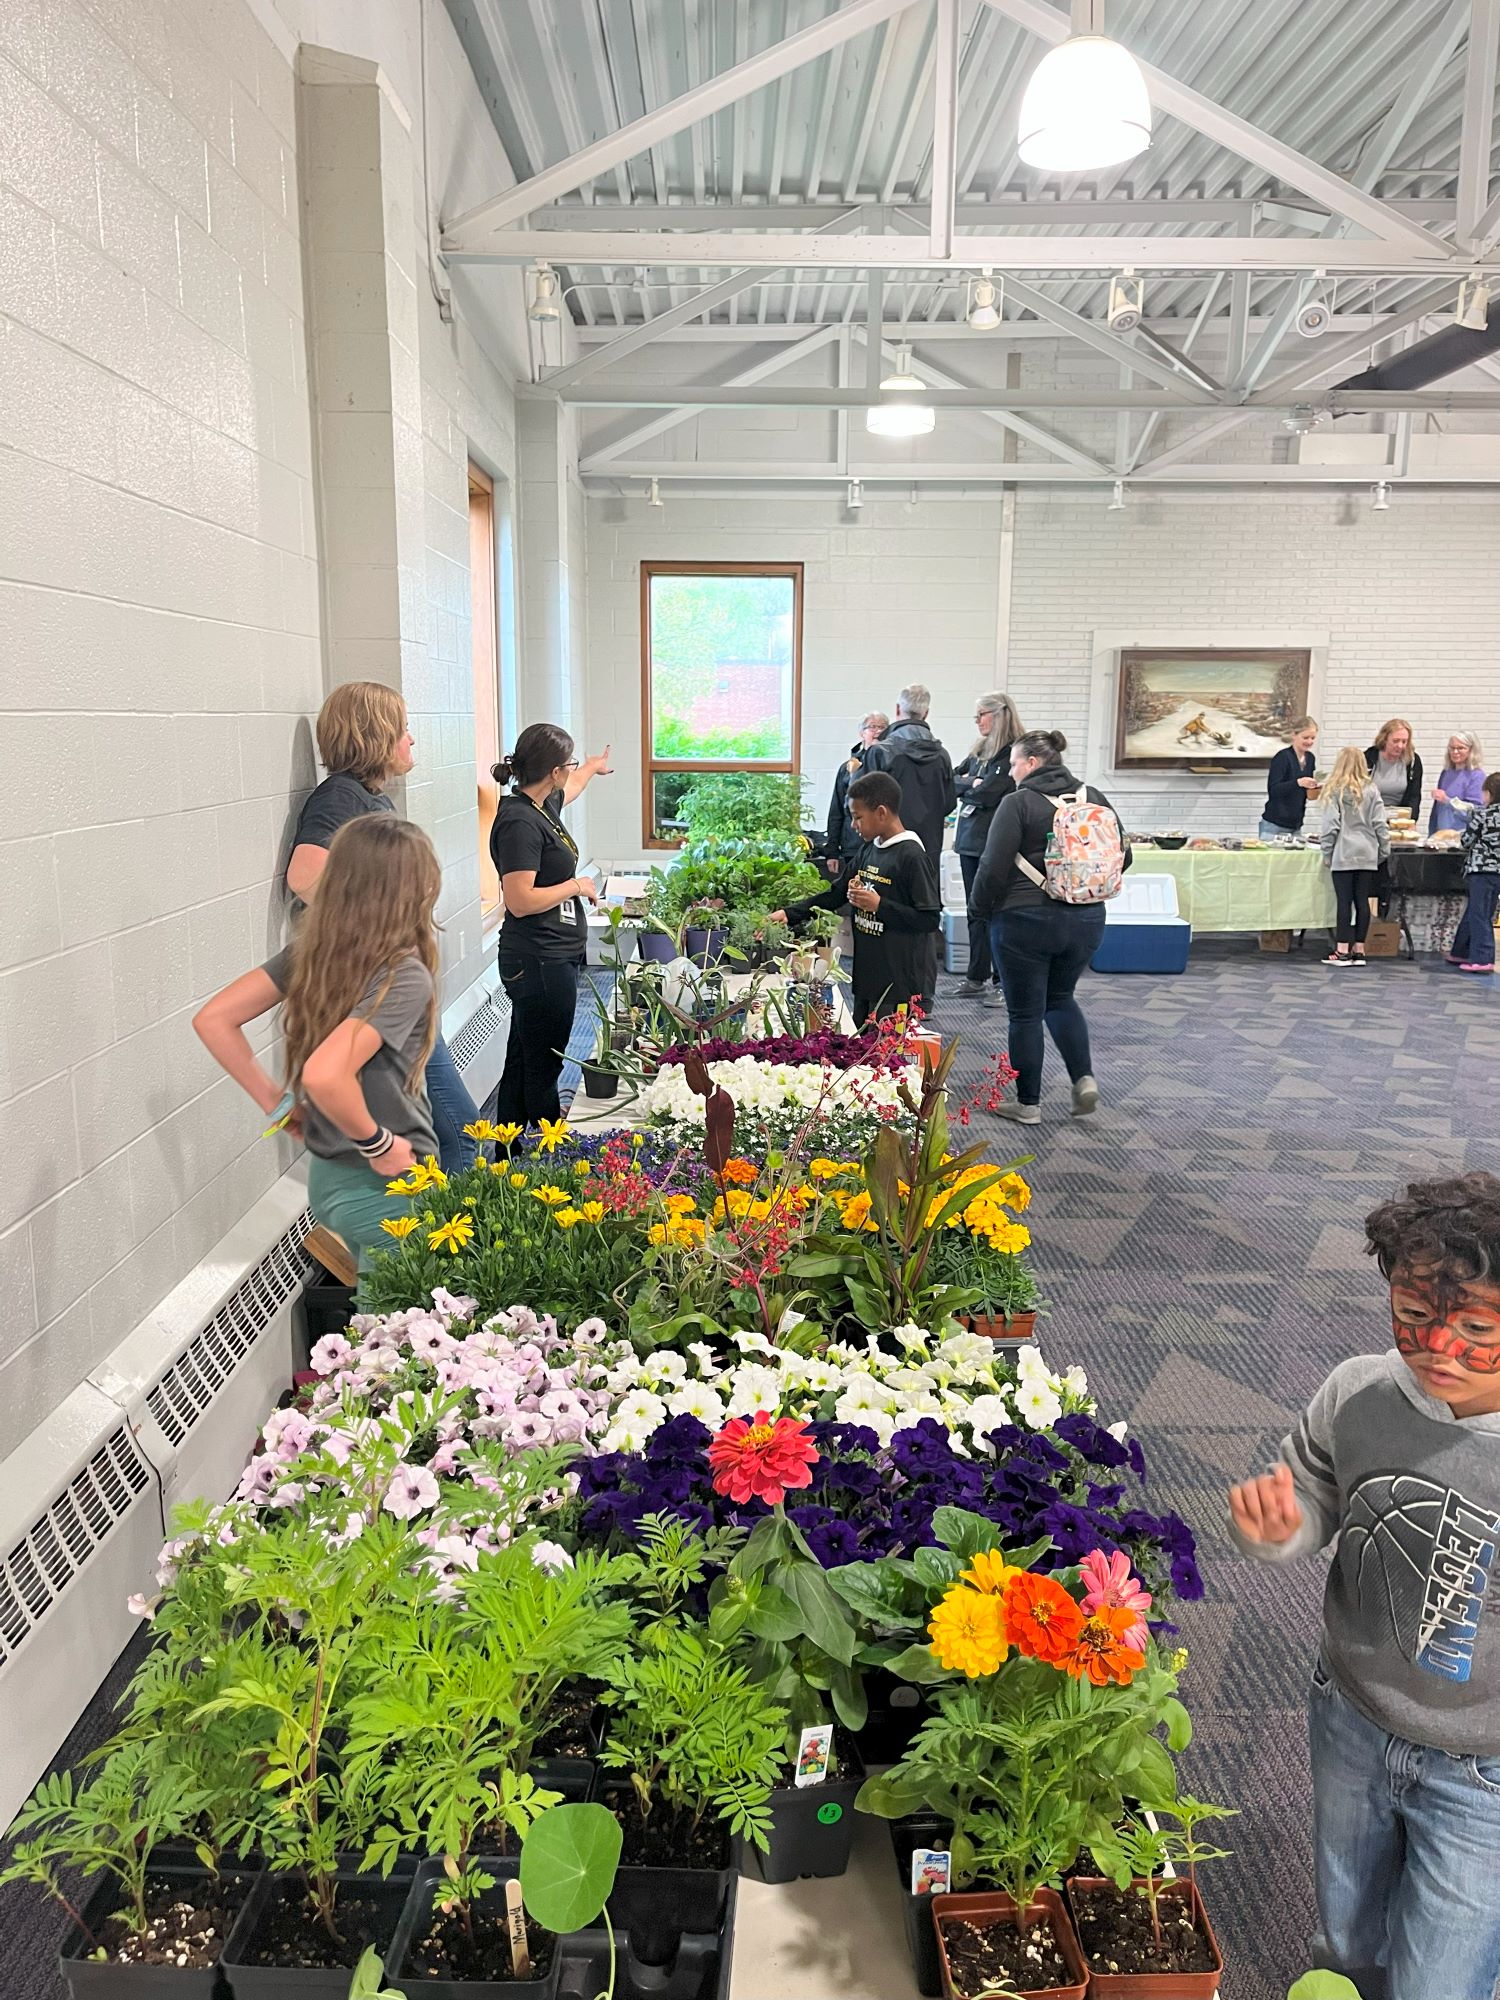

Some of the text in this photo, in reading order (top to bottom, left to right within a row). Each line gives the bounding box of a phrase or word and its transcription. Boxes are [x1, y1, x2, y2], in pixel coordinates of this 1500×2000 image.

[1416, 1487, 1500, 1683] LEGEND
[824, 1806, 836, 1819] $3
[509, 1905, 525, 1944] Marigold
